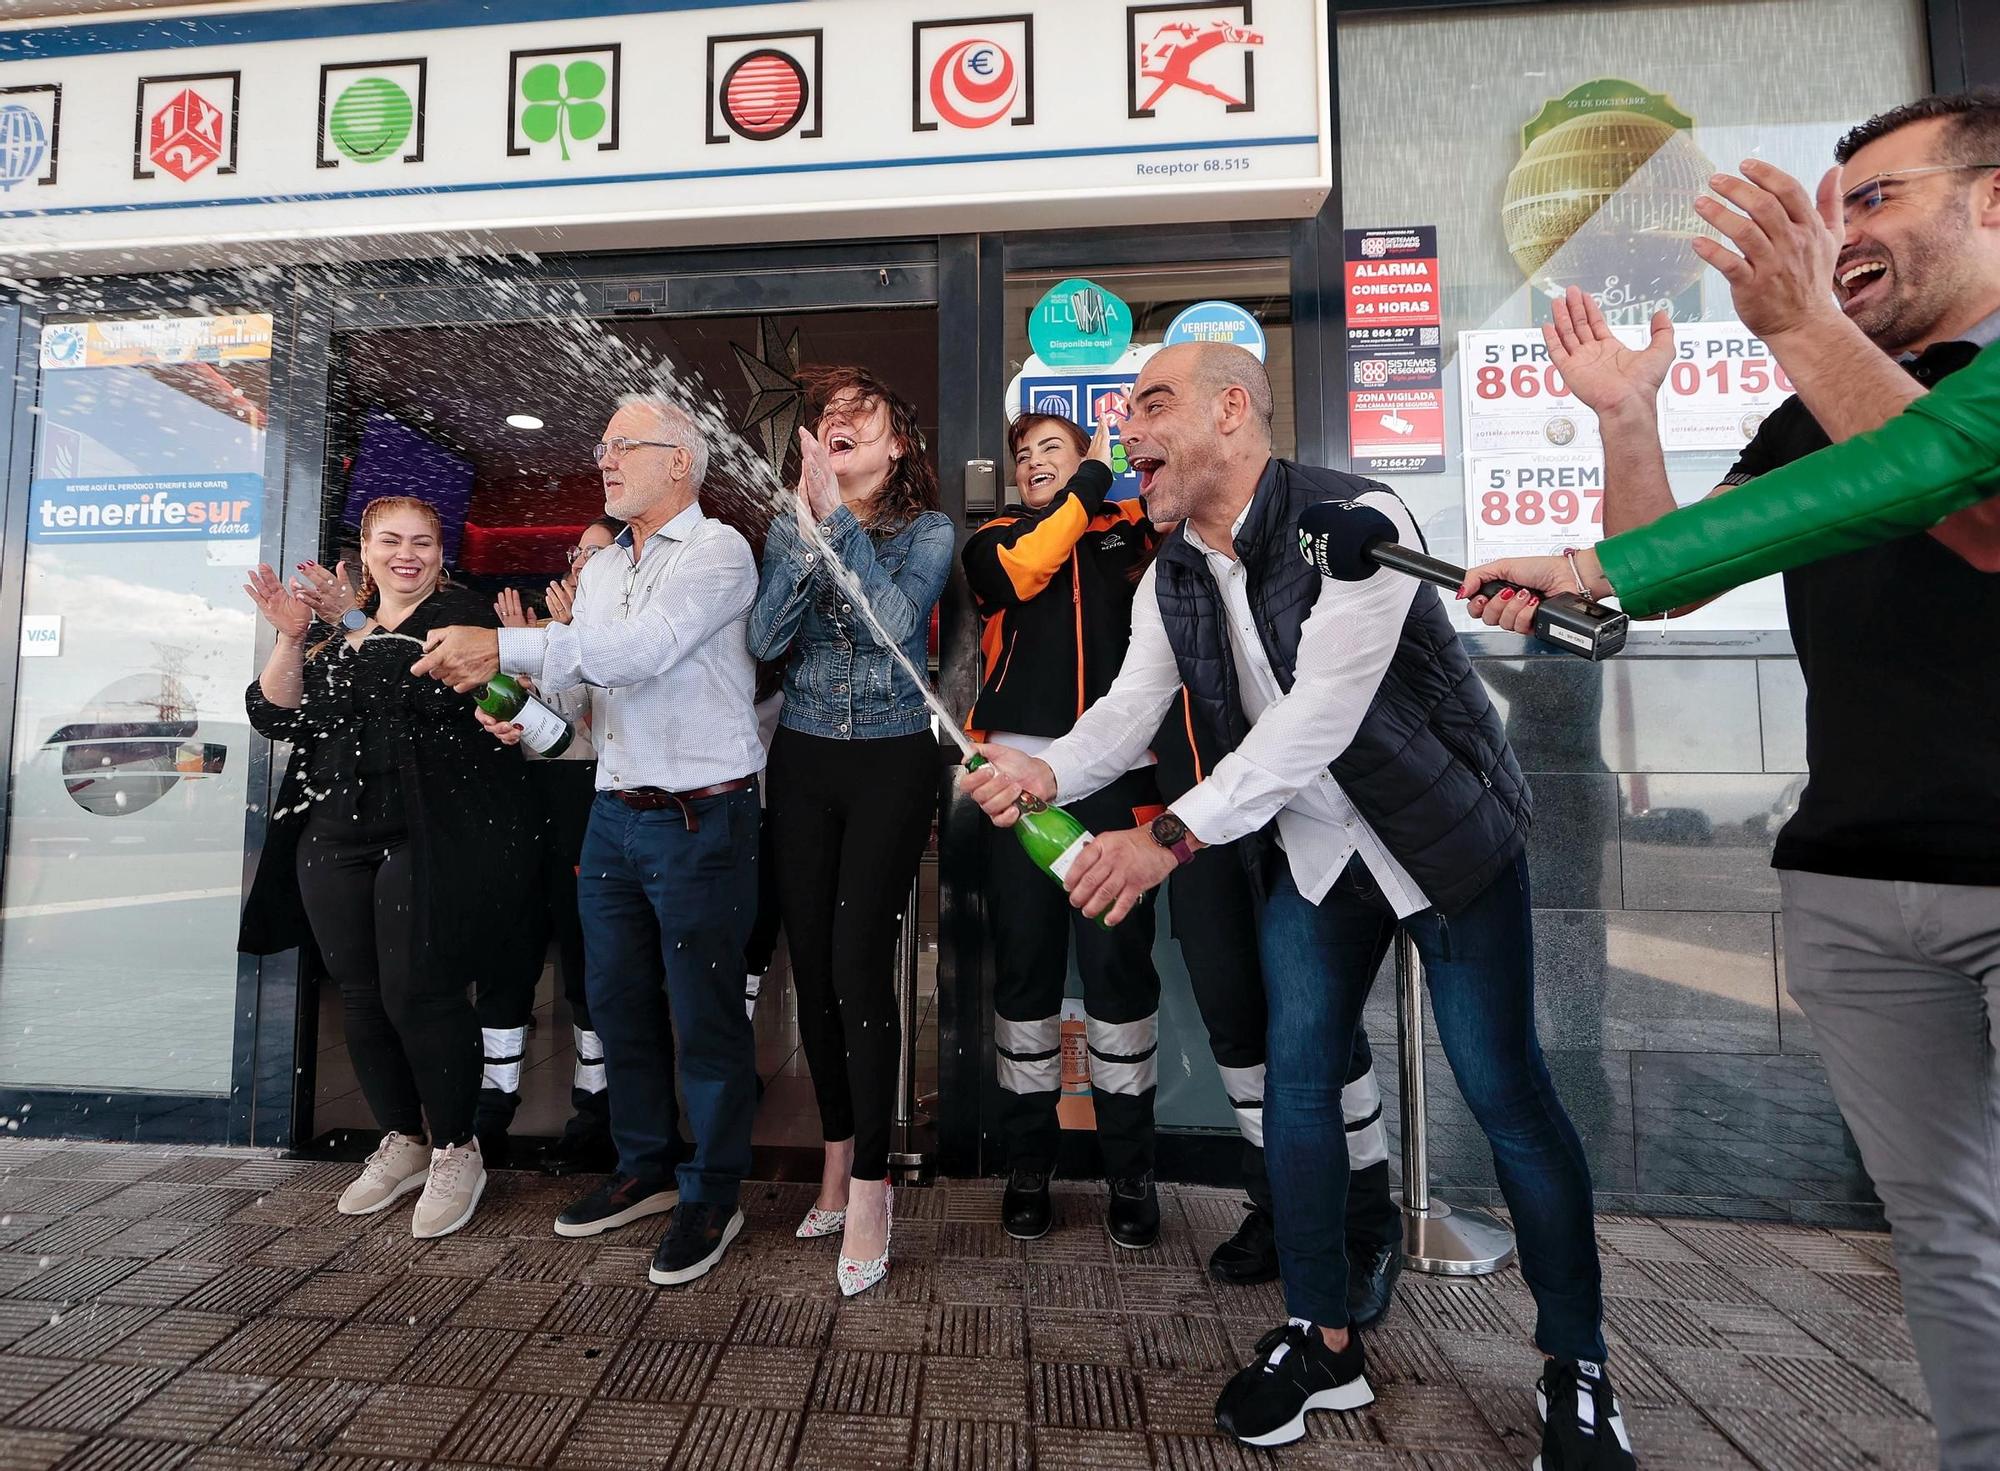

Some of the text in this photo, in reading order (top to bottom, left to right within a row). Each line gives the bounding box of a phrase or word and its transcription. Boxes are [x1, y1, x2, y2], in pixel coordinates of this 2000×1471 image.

[968, 50, 993, 75] €
[1567, 97, 1646, 108] 22 DE DICIEMBRE
[1137, 158, 1250, 176] Receptor 68.515
[1355, 262, 1428, 277] ALARMA
[1352, 283, 1432, 295] CONECTADA
[1355, 301, 1430, 314] 24 HORAS
[1181, 321, 1246, 333] VERIFICAMOS
[1349, 328, 1415, 338] 952 664 207
[1193, 332, 1233, 341] TU EDAD
[1049, 339, 1112, 349] Disponible aquí
[1707, 338, 1766, 358] PRE
[1388, 359, 1436, 367] SISTEMAS
[1476, 365, 1572, 399] 860
[1357, 392, 1435, 402] ZONA VIGILADA
[1370, 458, 1426, 467] 952 664 207
[1517, 467, 1599, 488] PREM
[108, 483, 117, 491] EL
[155, 481, 187, 490] TENERIFE
[188, 481, 202, 489] SUR
[203, 480, 228, 490] GRATIS
[1481, 489, 1604, 525] 8897
[209, 520, 250, 535] ahora
[1320, 533, 1332, 576] CANARIA
[27, 630, 56, 641] VISA
